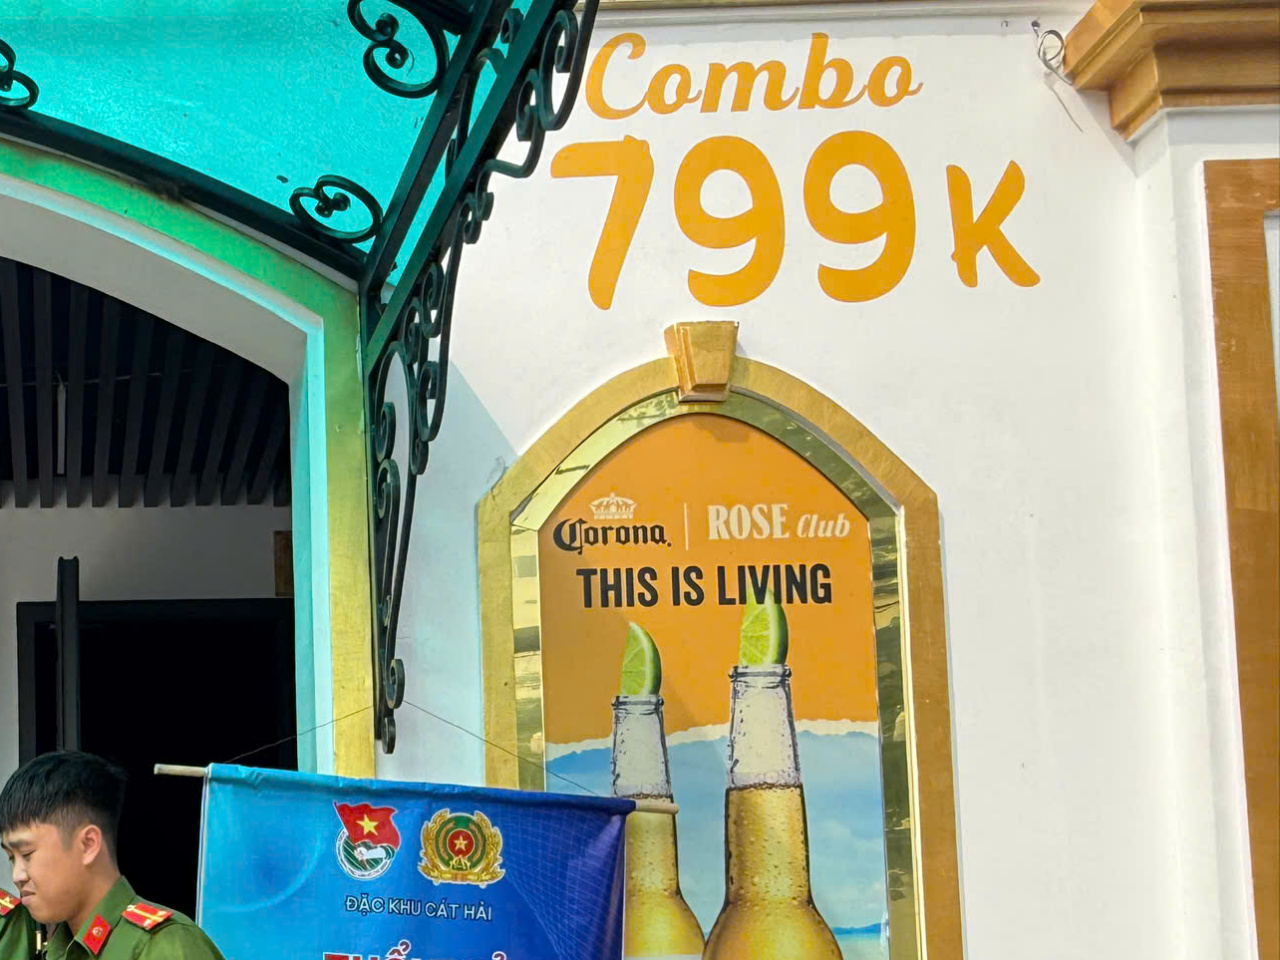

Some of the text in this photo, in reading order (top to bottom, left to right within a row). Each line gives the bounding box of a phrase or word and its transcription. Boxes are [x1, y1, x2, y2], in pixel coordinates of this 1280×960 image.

[584, 31, 924, 120] Combo
[707, 503, 850, 542] ROSE Club
[575, 563, 832, 609] THIS IS LIVING
[345, 893, 492, 921] ĐẶC KHU CÁT HẢI
